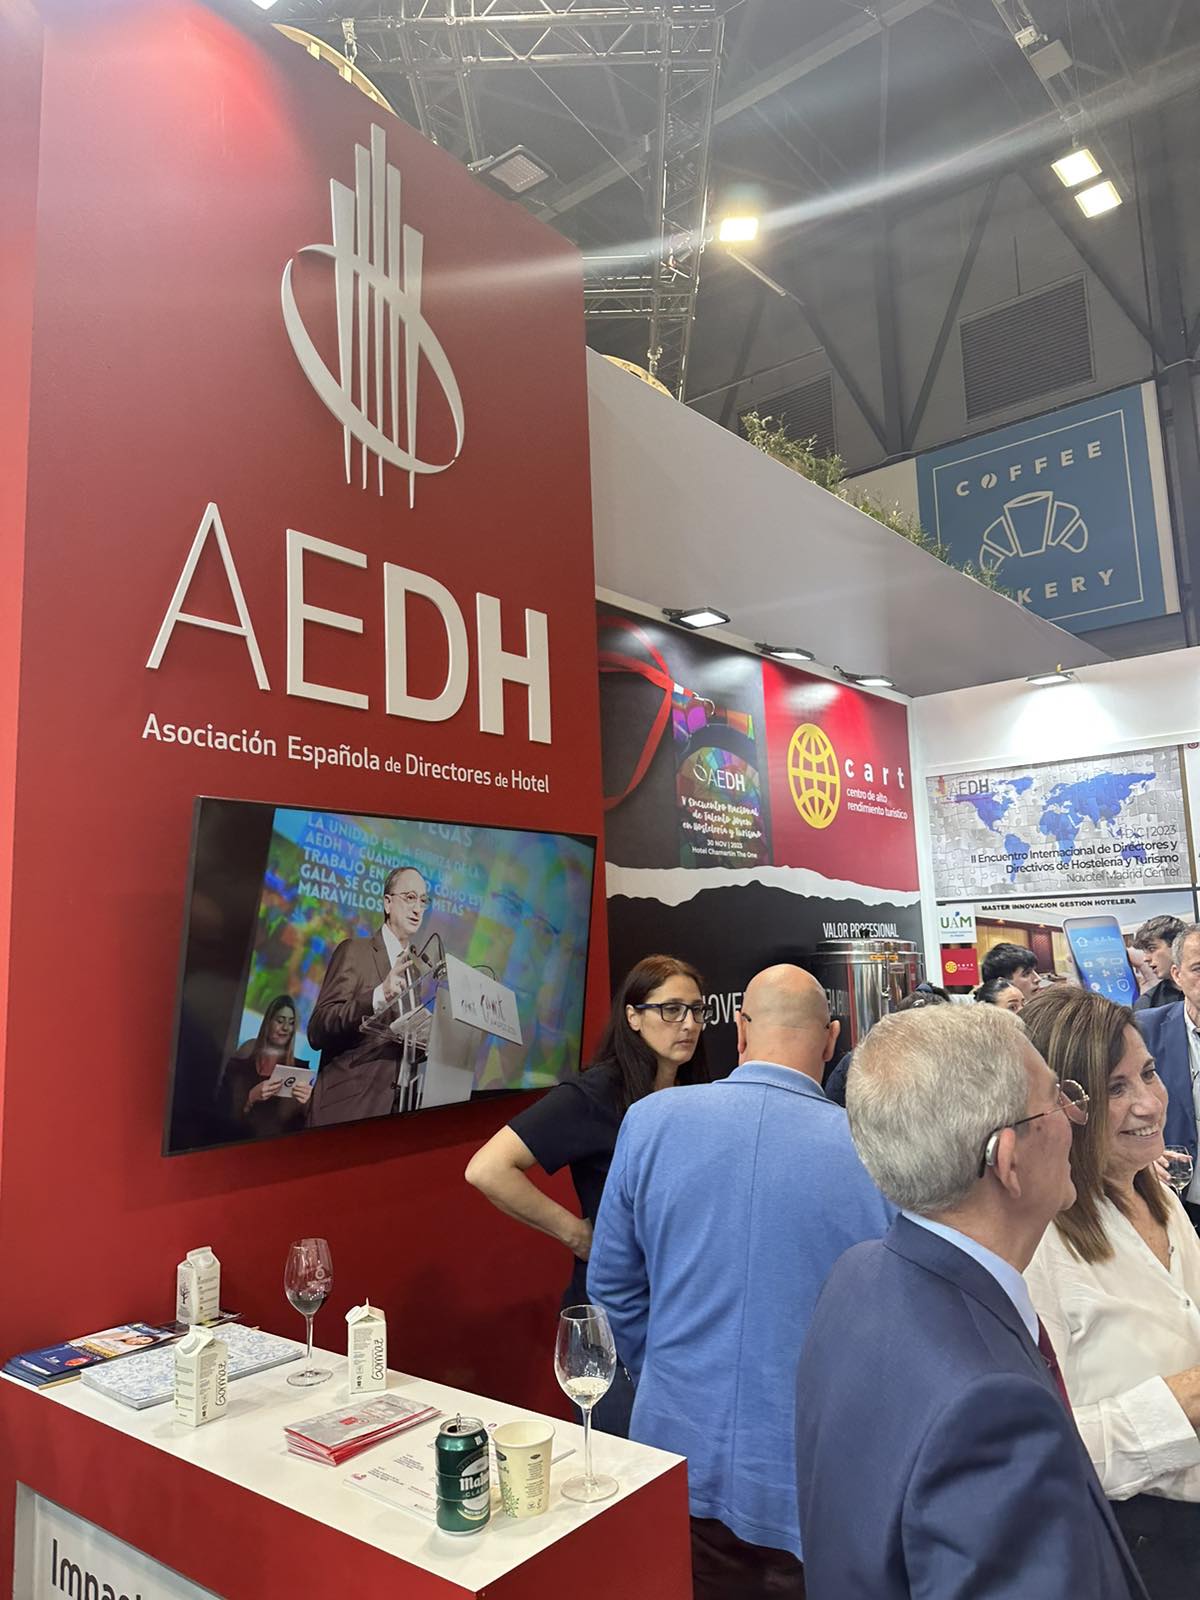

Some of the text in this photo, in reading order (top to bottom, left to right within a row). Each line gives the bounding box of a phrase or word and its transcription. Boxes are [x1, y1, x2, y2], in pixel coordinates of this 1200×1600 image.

[1017, 569, 1114, 605] KERY
[145, 502, 552, 744] AEDH
[141, 713, 551, 794] Asociación Española de Directores de Hotel
[707, 768, 746, 792] AEDH
[844, 758, 905, 789] cart
[688, 798, 727, 811] Encuentro
[846, 788, 867, 800] centro
[867, 790, 876, 801] de
[692, 809, 703, 820] de
[704, 811, 731, 823] Talento
[1151, 824, 1177, 836] 2023
[305, 830, 342, 853] AEDH
[692, 846, 708, 855] Hotel
[971, 840, 1178, 864] II Encuentro Internacional de Directores y
[303, 846, 385, 881] TRABAJO EN
[1006, 862, 1055, 873] Directivos
[1056, 860, 1070, 870] de
[1125, 858, 1132, 868] y
[1132, 853, 1180, 865] Turismo
[300, 863, 339, 888] GALA,
[343, 874, 360, 890] SE
[362, 879, 385, 896] CO
[1066, 867, 1180, 883] Novotel Madrid Center
[1012, 902, 1058, 910] INNOVACION
[1059, 900, 1093, 909] GESTION
[1094, 898, 1137, 906] HOTELERA
[822, 922, 849, 938] VALOR
[940, 915, 973, 929] UAM
